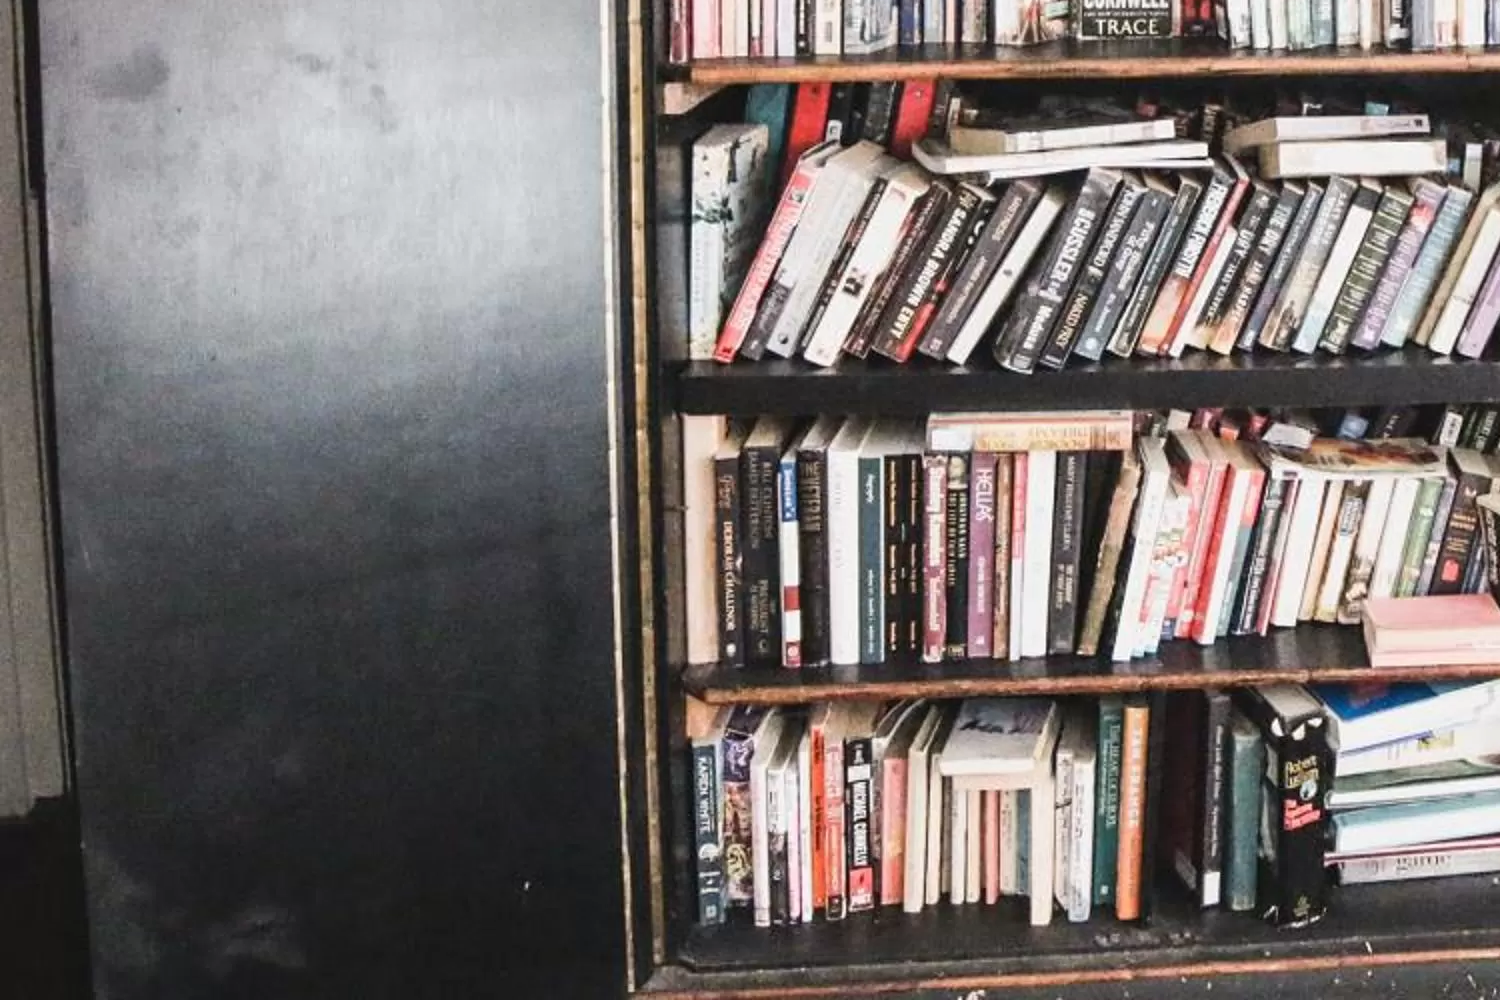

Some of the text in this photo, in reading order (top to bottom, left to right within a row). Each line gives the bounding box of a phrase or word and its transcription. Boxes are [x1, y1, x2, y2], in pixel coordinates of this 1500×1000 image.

[1095, 19, 1160, 35] TRACE
[1048, 214, 1093, 284] CUSSLER
[1230, 227, 1255, 258] DRY
[1256, 201, 1292, 256] THE DRY
[889, 204, 967, 339] SANDRA BROWN ENVY
[1064, 292, 1088, 327] NAKED
[747, 451, 760, 548] JAMES PATTERSON
[975, 467, 995, 521] HELLAS
[1066, 456, 1076, 481] MARY
[762, 461, 773, 540] BILL CLINTON
[722, 521, 736, 630] DEBORAH CHALLINOR
[758, 579, 768, 633] PRESIDENT
[697, 757, 711, 833] KAREN WHITE
[852, 781, 868, 866] MICHAEL CONNELLY
